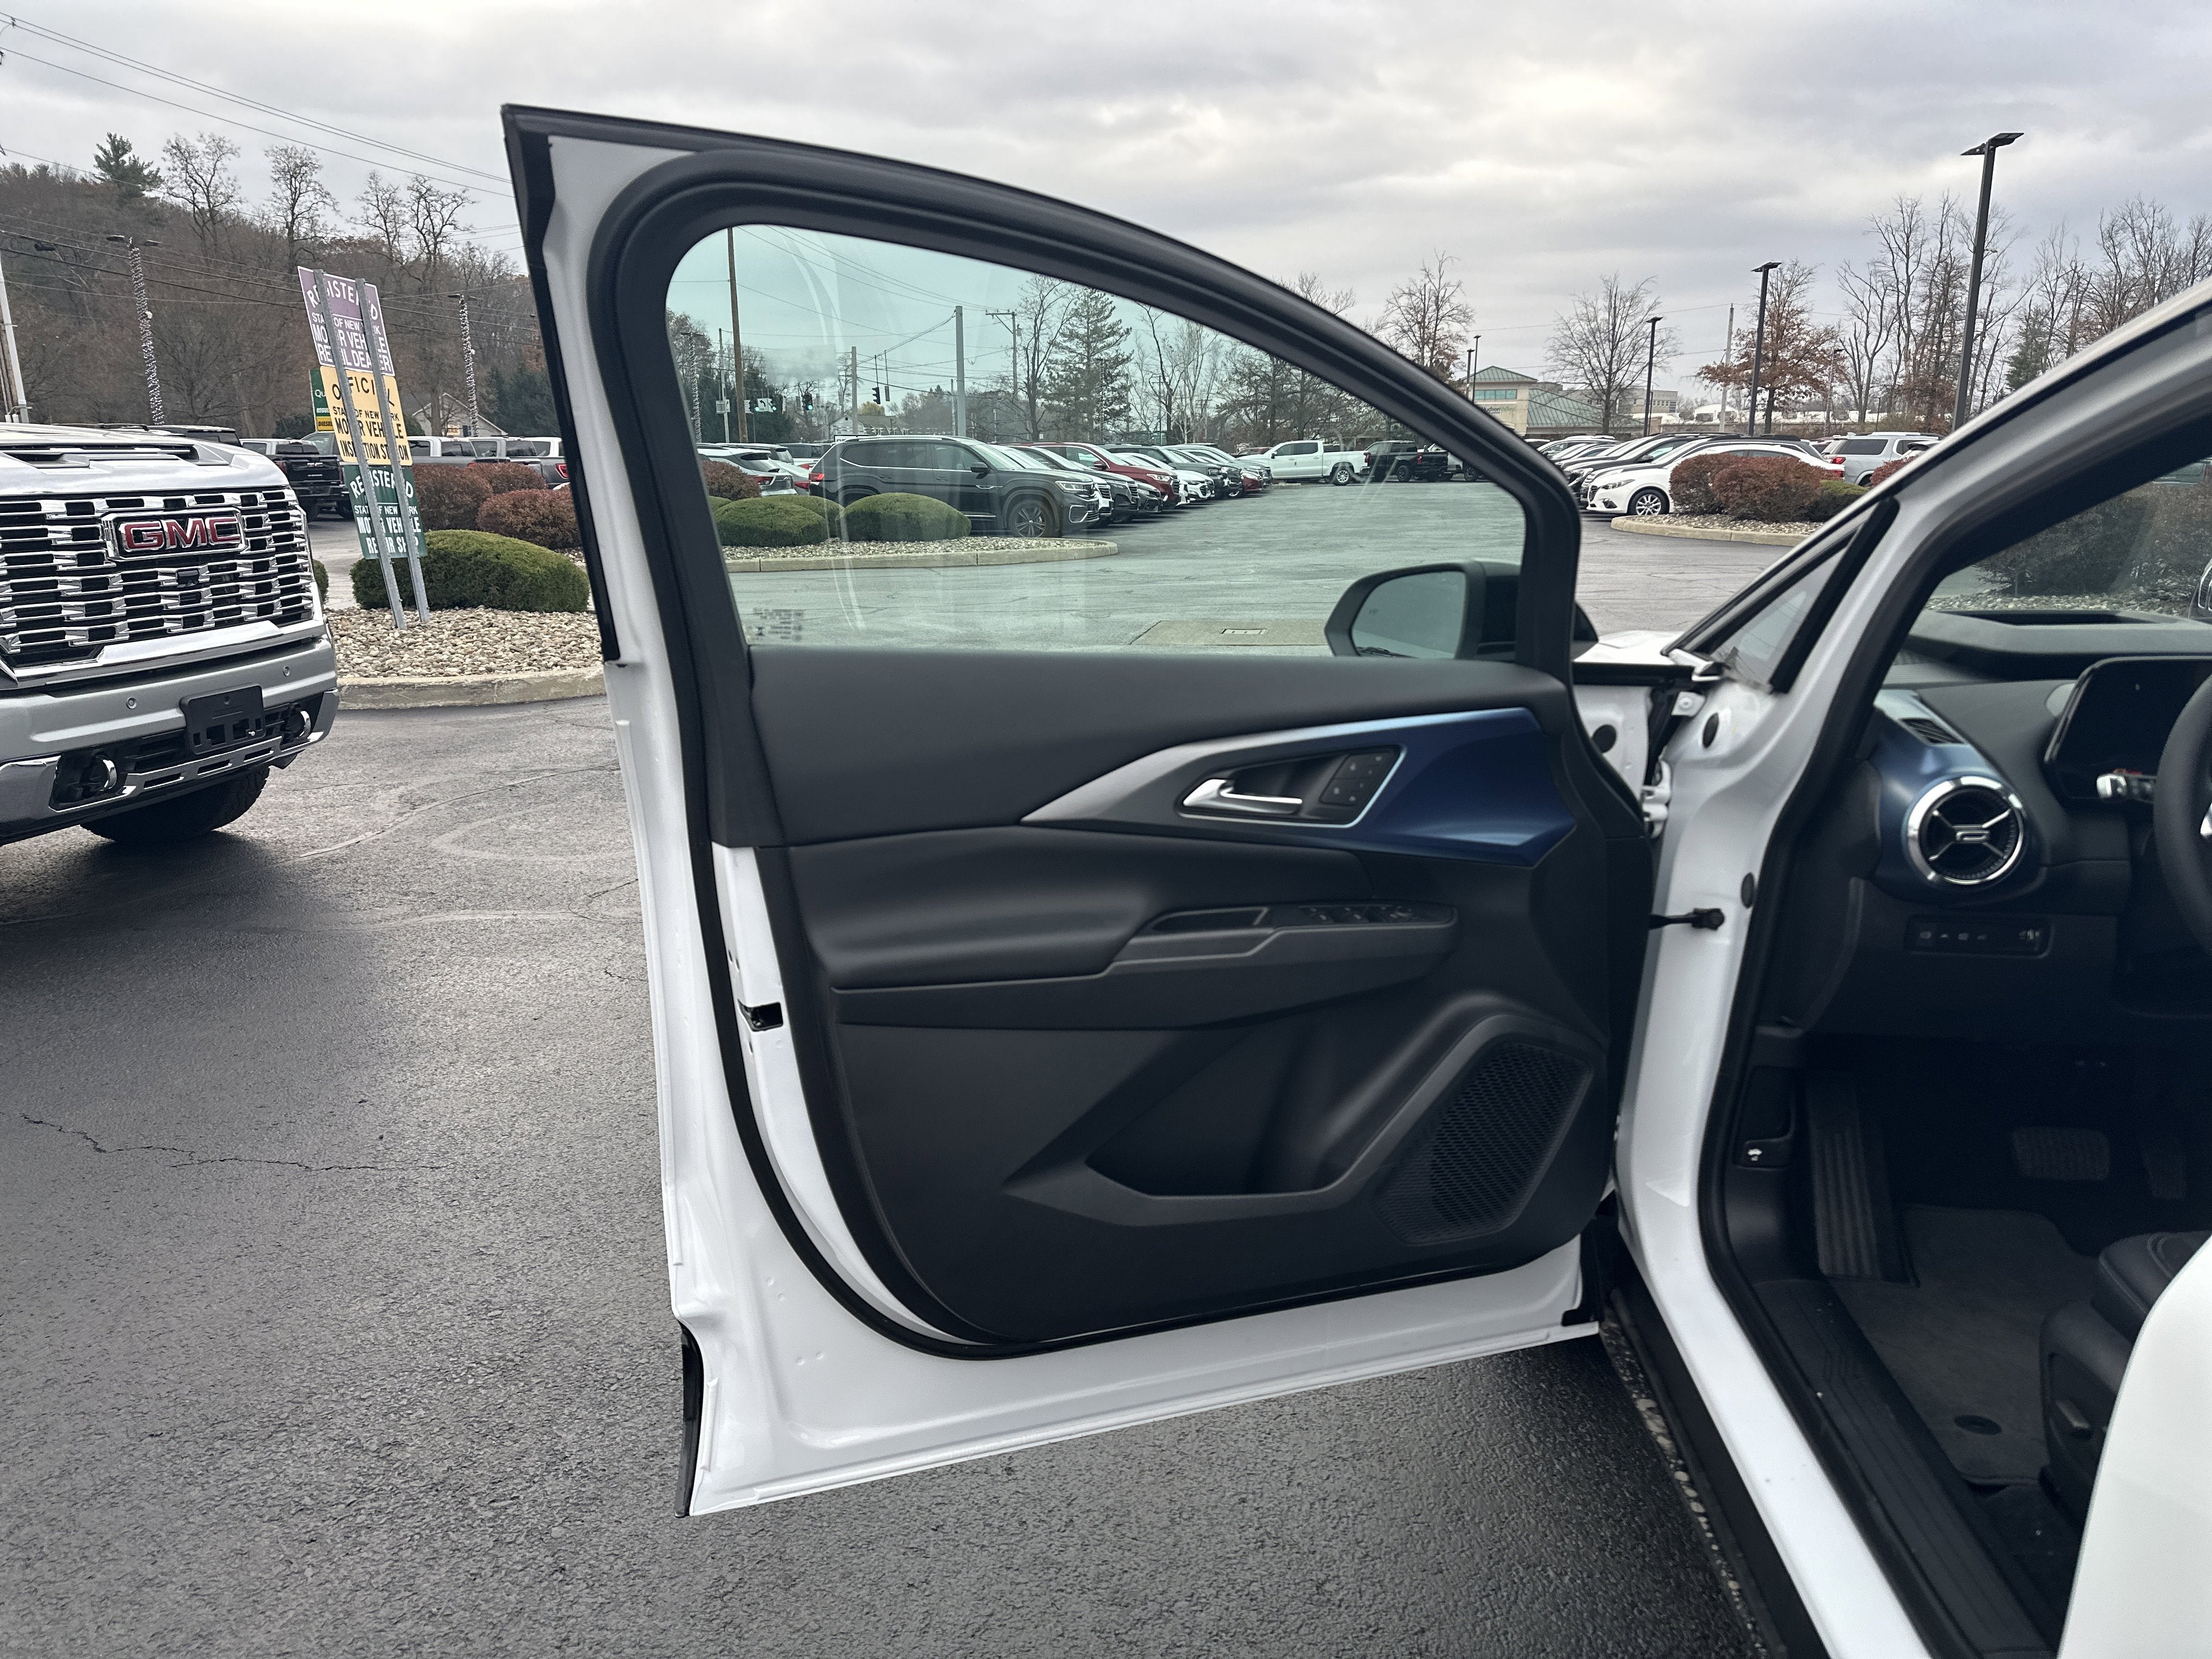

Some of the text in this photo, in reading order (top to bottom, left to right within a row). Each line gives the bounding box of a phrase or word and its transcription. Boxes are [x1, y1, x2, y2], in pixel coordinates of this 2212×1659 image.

[312, 312, 325, 324] STA
[334, 317, 343, 328] OF
[345, 321, 360, 331] NEW
[312, 324, 347, 347] MOR
[317, 343, 352, 366] REIL
[332, 405, 346, 417] STA
[365, 410, 379, 420] NEW
[335, 417, 366, 437] MOR
[354, 505, 369, 514] STAT
[384, 506, 398, 515] NEW
[118, 517, 241, 552] GMC
[386, 517, 421, 533] VEHLE
[366, 537, 396, 554] REIR
